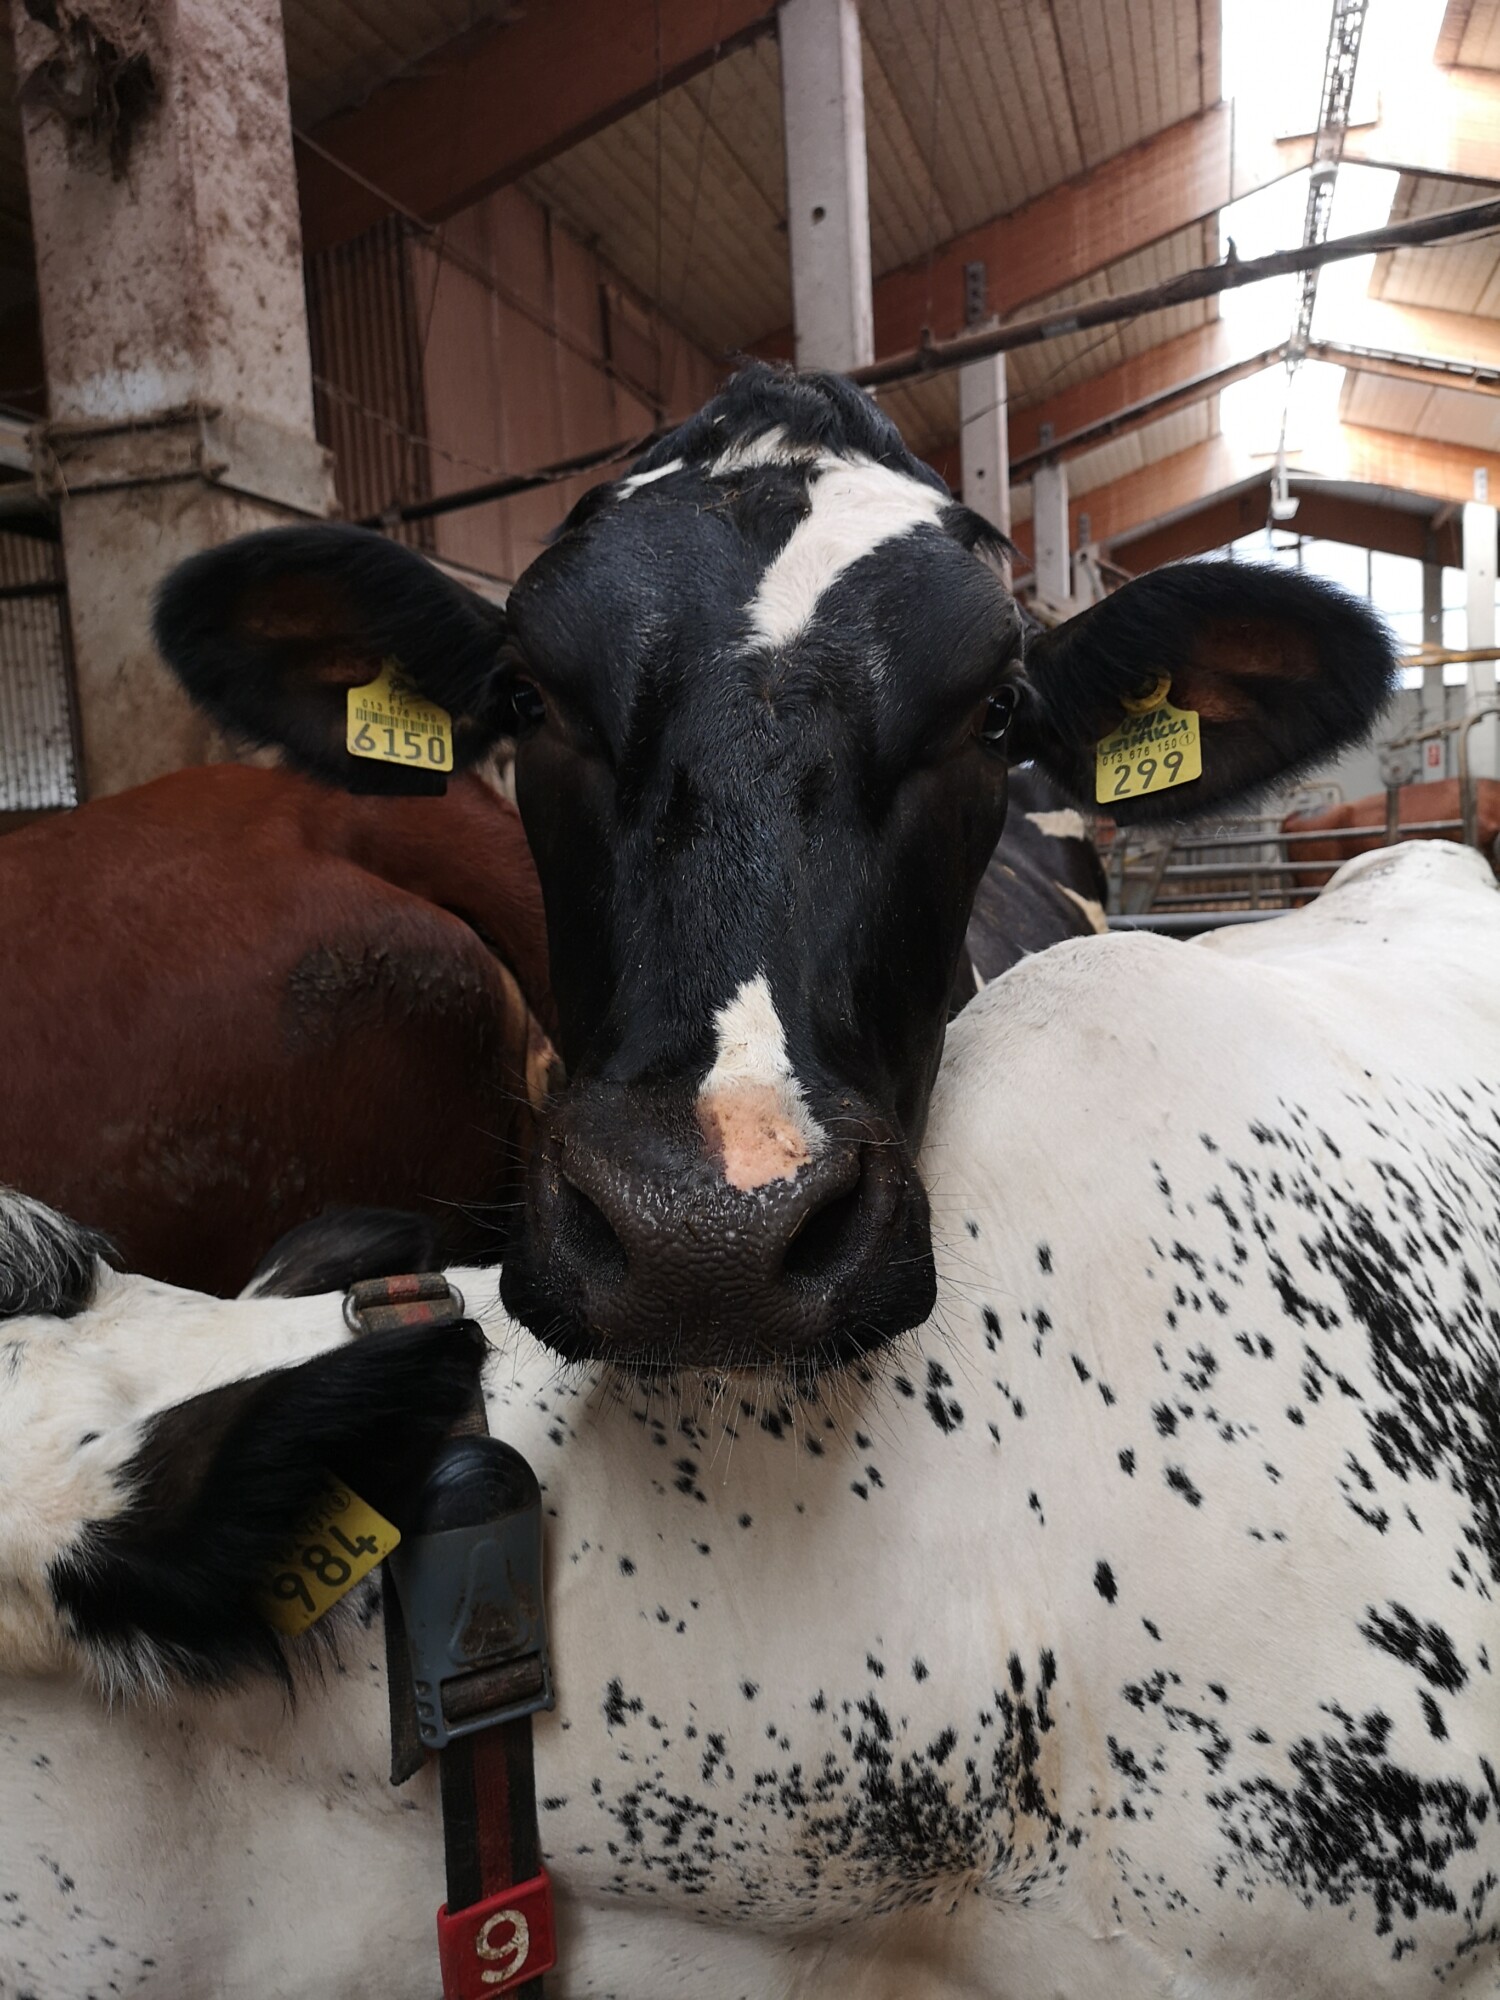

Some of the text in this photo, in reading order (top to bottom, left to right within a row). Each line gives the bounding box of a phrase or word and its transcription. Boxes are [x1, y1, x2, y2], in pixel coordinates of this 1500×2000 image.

[362, 699, 383, 712] 013
[354, 723, 446, 765] 6150
[1102, 753, 1123, 766] 013
[1129, 746, 1150, 760] 676
[1157, 738, 1177, 752] 150
[1114, 750, 1184, 796] 299
[273, 1525, 379, 1612] 984
[476, 1909, 529, 1984] 9
